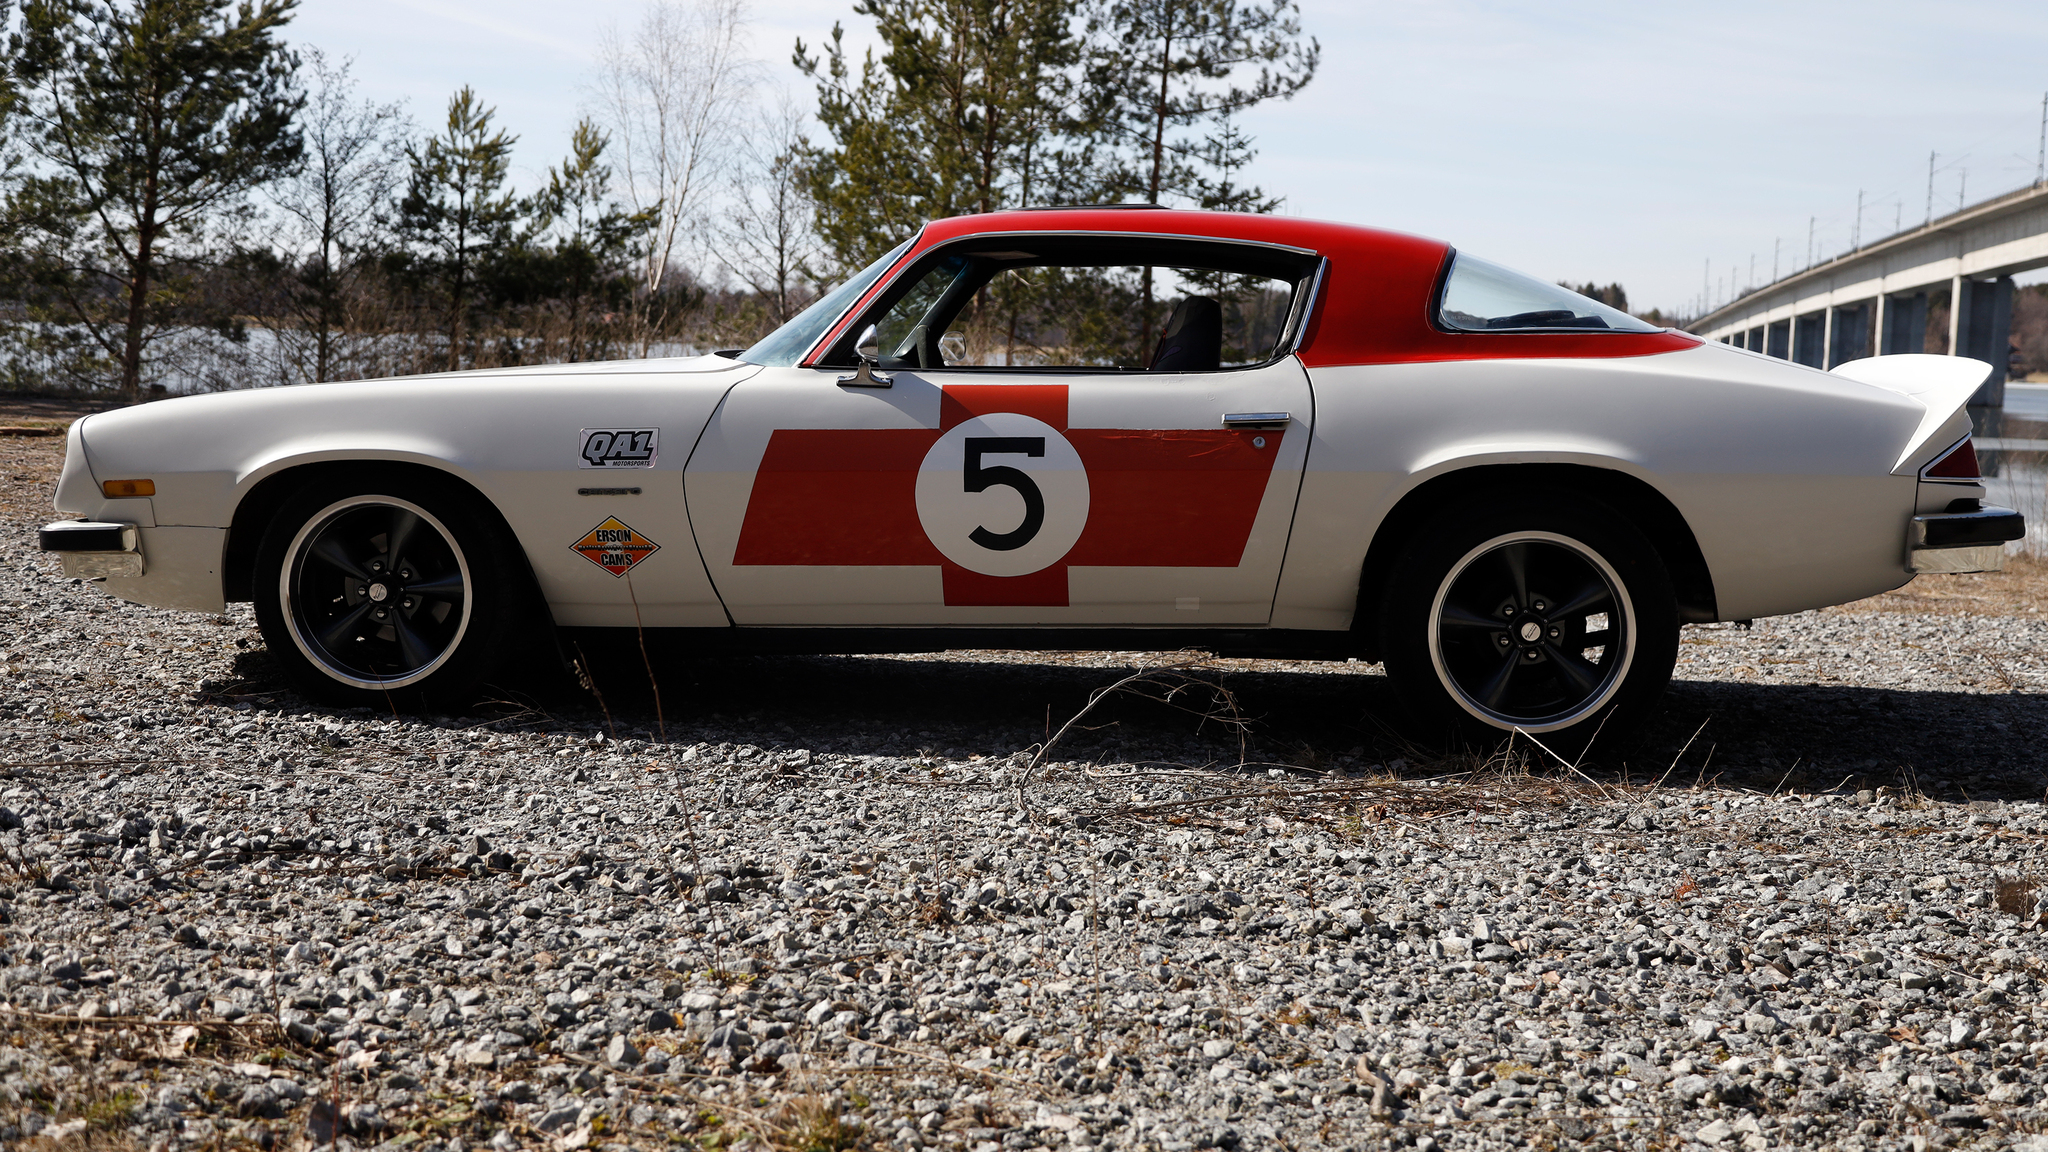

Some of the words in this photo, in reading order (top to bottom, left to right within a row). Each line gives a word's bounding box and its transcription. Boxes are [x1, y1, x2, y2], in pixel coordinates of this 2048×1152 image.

[582, 431, 654, 466] QA1
[963, 437, 1045, 551] 5
[596, 529, 632, 542] ERSON
[600, 553, 633, 566] CAMS
